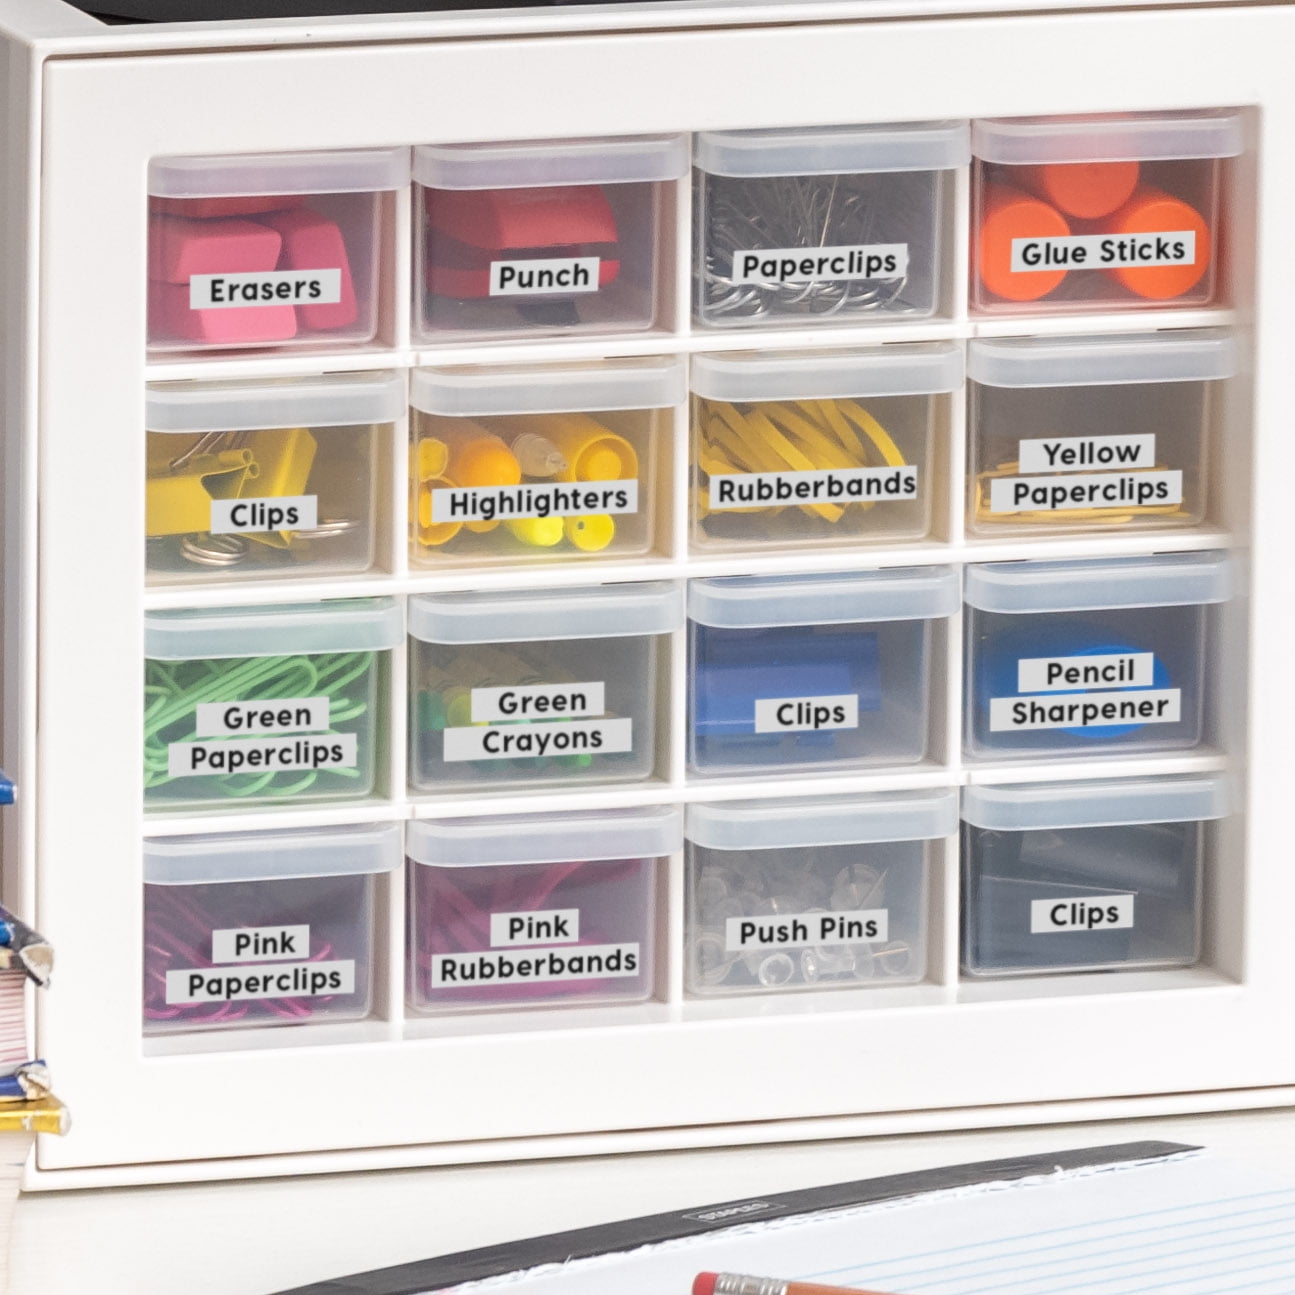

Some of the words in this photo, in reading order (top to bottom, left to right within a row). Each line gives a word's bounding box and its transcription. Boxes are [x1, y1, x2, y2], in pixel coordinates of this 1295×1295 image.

[743, 250, 897, 280] Paperclips
[1021, 242, 1087, 266] Glue
[1100, 237, 1185, 263] Sticks
[210, 278, 321, 303] Erasers
[499, 263, 589, 290] Punch
[1043, 441, 1141, 466] Yellow
[719, 471, 916, 503] Rubberbands
[1014, 478, 1169, 508] Paperclips
[230, 502, 299, 531] Clips
[450, 488, 628, 520] Highlighters
[1047, 658, 1134, 685] Pencil
[498, 691, 586, 715] Green
[776, 702, 846, 730] Clips
[1012, 699, 1169, 726] Sharpener
[223, 706, 311, 730] Green
[191, 741, 344, 773] Paperclips
[482, 730, 603, 756] Crayons
[509, 914, 569, 940] Pink
[1050, 902, 1119, 930] Clips
[235, 931, 296, 957] Pink
[740, 919, 808, 945] Push
[820, 916, 878, 940] Pins
[441, 948, 637, 982] Rubberbands
[189, 967, 342, 999] Paperclips
